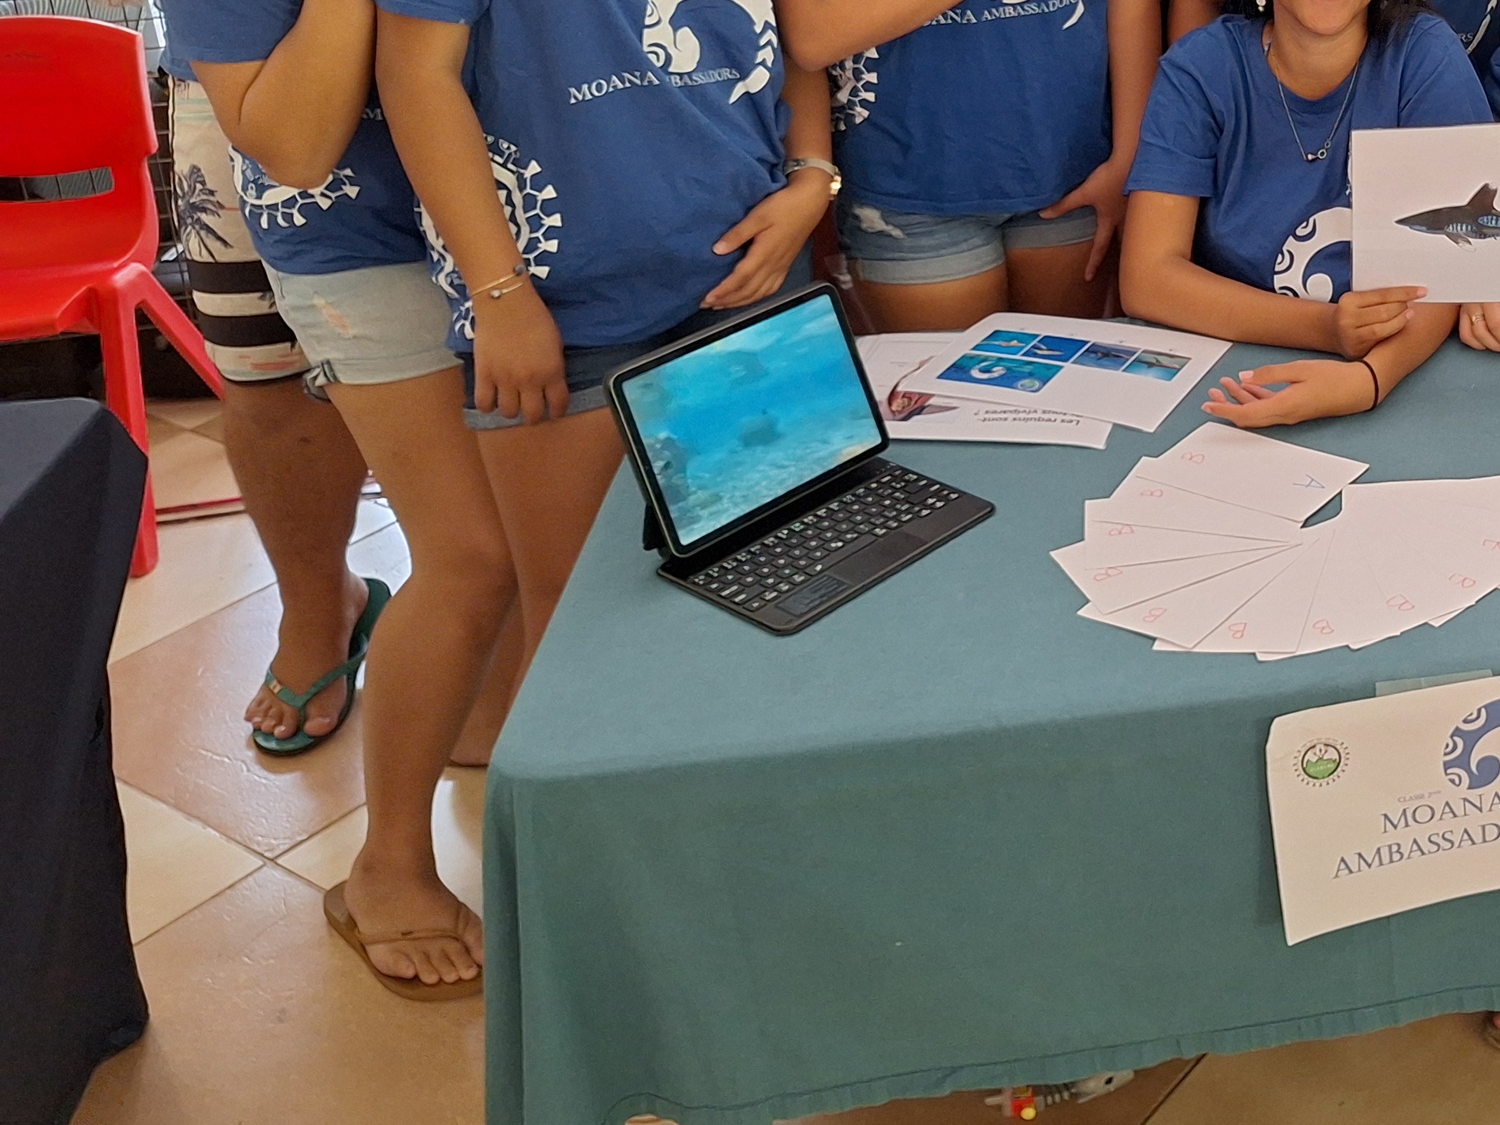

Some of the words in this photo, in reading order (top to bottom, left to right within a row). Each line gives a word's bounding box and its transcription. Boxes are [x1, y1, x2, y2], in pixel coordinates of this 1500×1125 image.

[567, 70, 660, 105] MOANA
[1012, 416, 1057, 424] requins
[1060, 418, 1080, 426] Les
